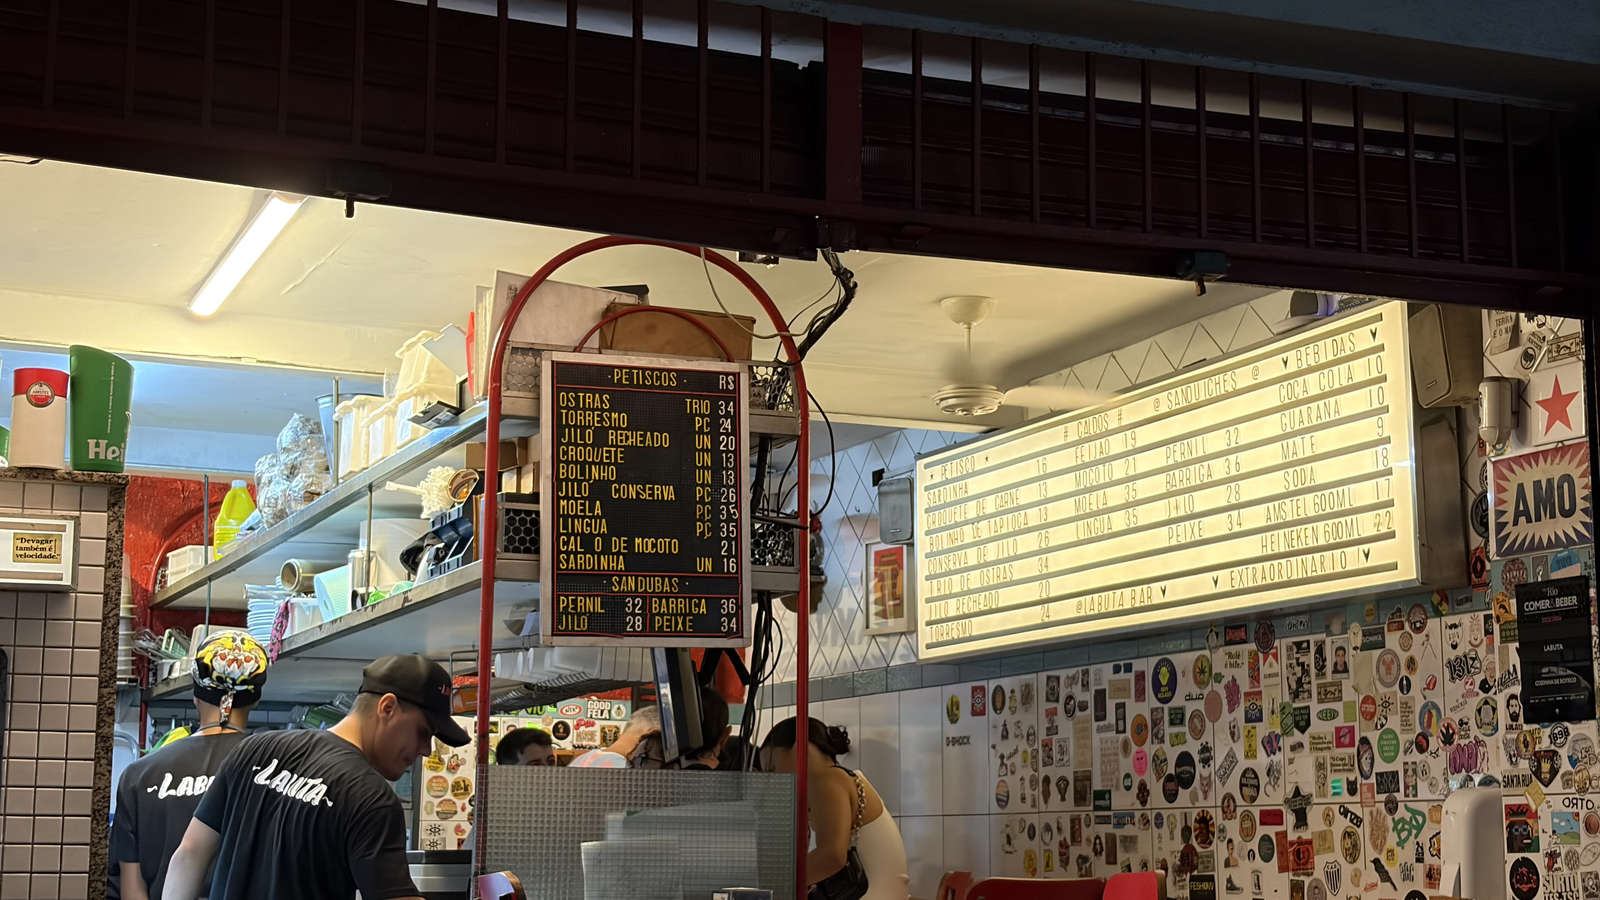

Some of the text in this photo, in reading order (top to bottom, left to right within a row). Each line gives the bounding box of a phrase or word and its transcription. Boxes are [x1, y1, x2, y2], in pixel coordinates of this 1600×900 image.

[1296, 333, 1355, 369] BEBIDAS
[614, 369, 677, 386] PETISCOS
[1167, 371, 1237, 409] SANDUICHES
[1279, 355, 1383, 403] COCA COLA 10
[560, 392, 734, 415] OSTRAS TRIO 34
[1280, 386, 1384, 432] GUARANA 10
[561, 410, 627, 428] TORRESMO
[720, 419, 731, 433] 24
[1077, 413, 1108, 439] CALDOS
[609, 431, 669, 447] RECHEADO
[696, 435, 710, 449] UN
[720, 436, 735, 450] 20
[1075, 431, 1136, 464] FEIJAO 19
[1166, 428, 1240, 464] PERNIL 32
[1281, 417, 1383, 461] MATE 9
[559, 446, 734, 467] CROQUETE UN 13
[941, 456, 976, 480] PETISCO
[1284, 448, 1389, 491] SODA 18
[559, 464, 734, 485] BOLINHO UN 13
[928, 457, 1047, 507] SARDINHA 16
[1075, 457, 1136, 489] MOCOTO 21
[1166, 456, 1241, 490] BARRIGA 36
[612, 485, 674, 500] CONSERVA
[721, 489, 735, 502] 26
[976, 499, 986, 516] DE
[994, 489, 1020, 510] CARNE
[1038, 482, 1047, 498] 13
[1075, 482, 1137, 514] MOELA 35
[1227, 484, 1240, 504] 28
[1266, 478, 1390, 524] AMSTEL 600ML 17
[1512, 473, 1576, 527] AMO
[559, 500, 601, 516] MOELA
[720, 505, 738, 519] 35
[1076, 509, 1138, 539] LINGUA 35
[560, 519, 607, 534] LINGUA
[720, 523, 736, 537] 35
[930, 530, 964, 552] BOLINHO
[988, 512, 1028, 533] TAPIOCA
[1039, 506, 1048, 522] 13
[1168, 511, 1242, 544] PEIXE 34
[1262, 511, 1392, 553] HEINEKEN 600ML 22
[16, 544, 47, 552] também
[612, 537, 627, 552] DE
[635, 539, 679, 554] MOCOTO
[721, 541, 736, 555] 21
[928, 530, 1049, 574] CONSERVA DE JILO 26
[560, 554, 736, 573] SARDINHA UN 16
[929, 557, 1048, 598] TRIO DE OSTRAS 34
[1230, 551, 1347, 588] EXTRAORDINARIO
[612, 576, 679, 592] SANDUBAS
[956, 591, 999, 614] RECHEADO
[1039, 580, 1050, 598] 20
[559, 597, 736, 614] PERNIL 32 BARRIGA 36
[1076, 586, 1153, 615] @LABUTA BAR
[1524, 599, 1550, 611] COMER
[1555, 596, 1577, 607] BEBER
[626, 617, 642, 631] 28
[655, 616, 693, 632] PEIXE
[721, 618, 736, 632] 34
[929, 606, 1050, 641] TORRESMO 24
[587, 700, 610, 711] GOOD
[588, 710, 609, 719] FELA
[1550, 726, 1570, 744] 1898
